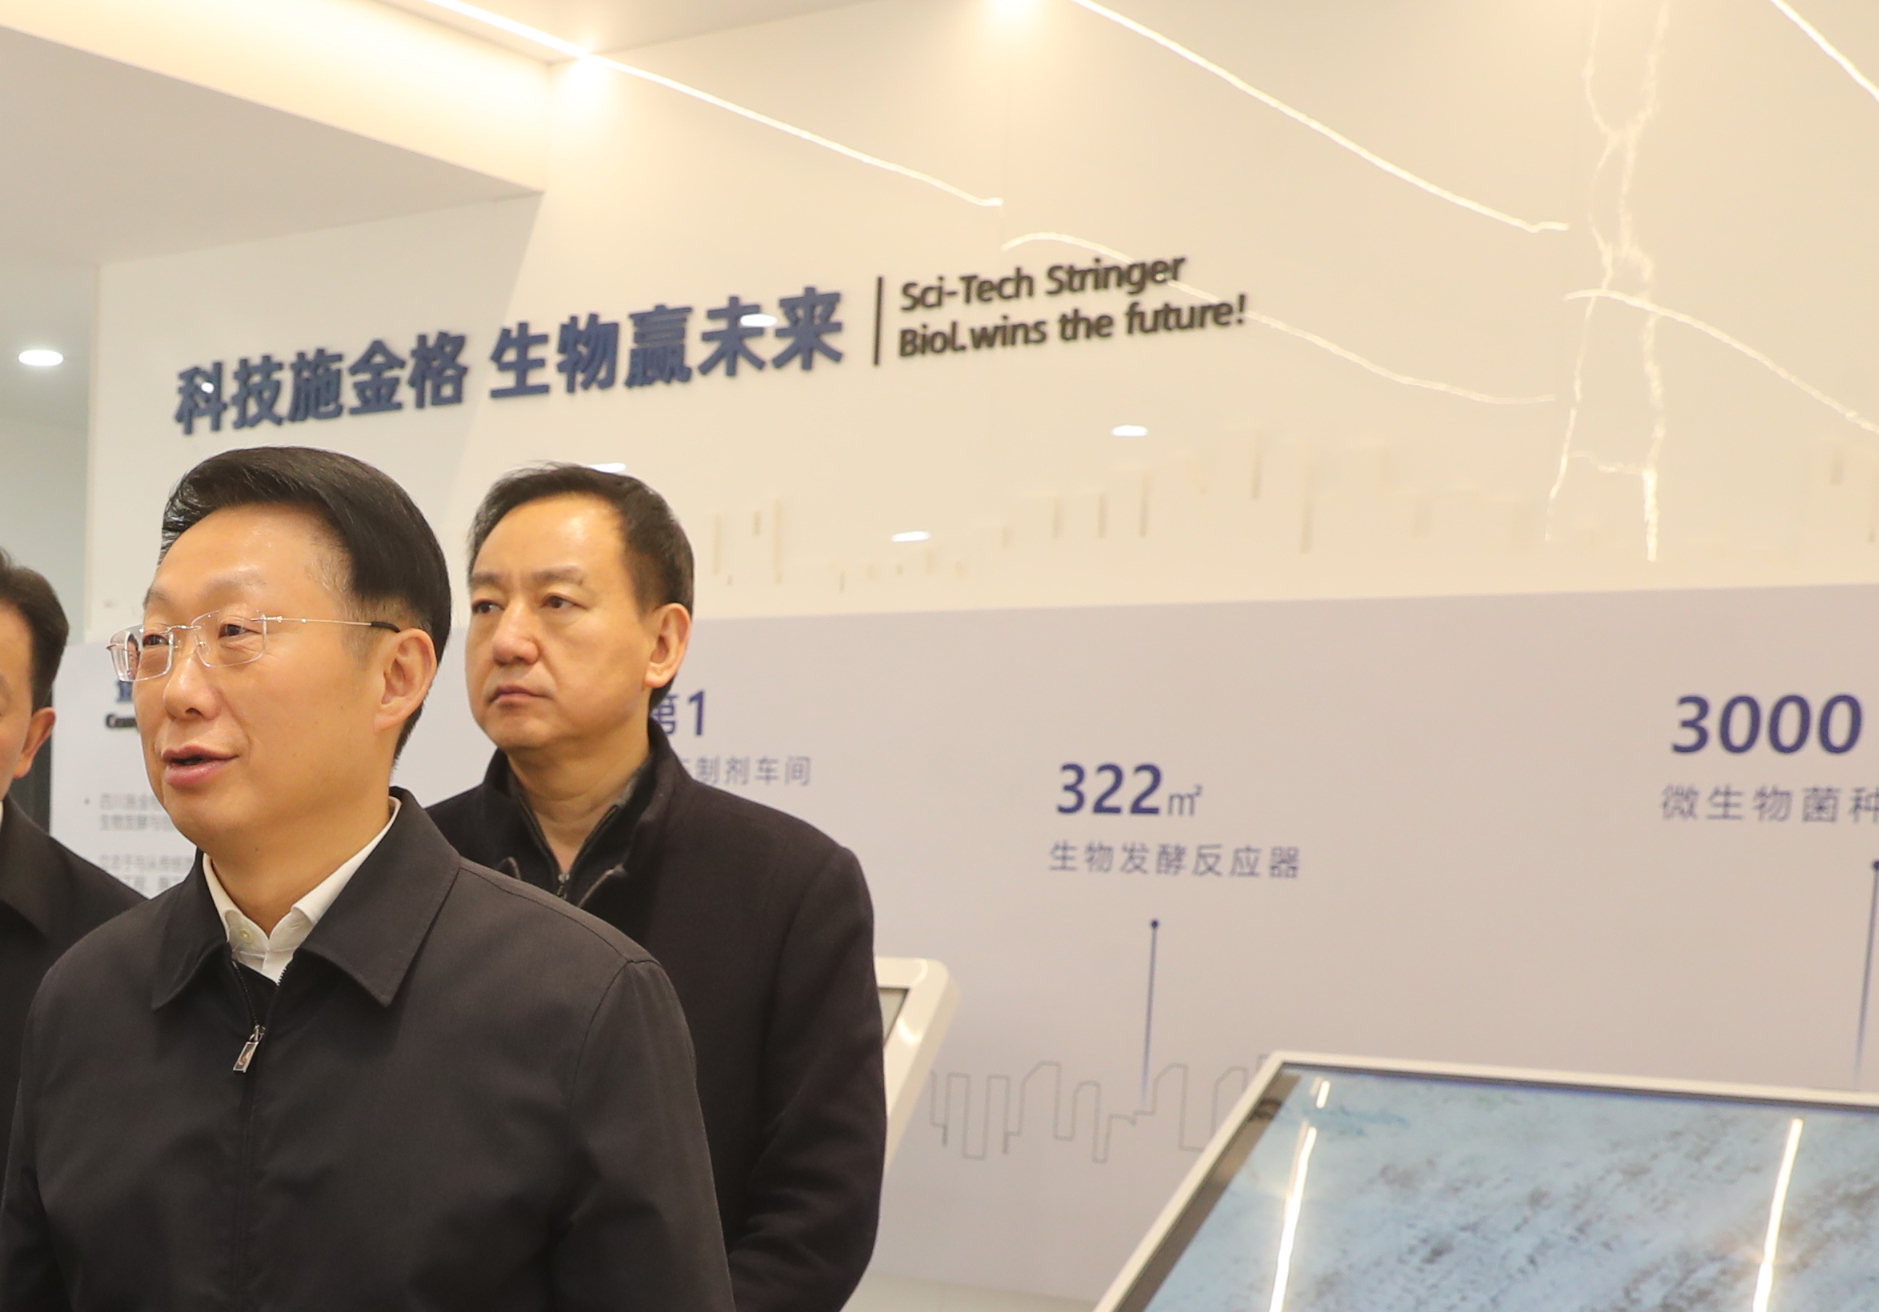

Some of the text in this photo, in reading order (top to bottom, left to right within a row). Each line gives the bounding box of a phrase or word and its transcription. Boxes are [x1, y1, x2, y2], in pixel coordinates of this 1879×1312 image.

[901, 257, 1186, 311] Sci-Tech Stringer
[1059, 308, 1113, 341] the
[1126, 293, 1246, 335] future!
[175, 286, 844, 435] 科技施金格 生物赢未来
[1672, 694, 1862, 754] 3000
[681, 756, 812, 787] 制剂车间
[1049, 840, 1299, 879] 生物发酵反应器
